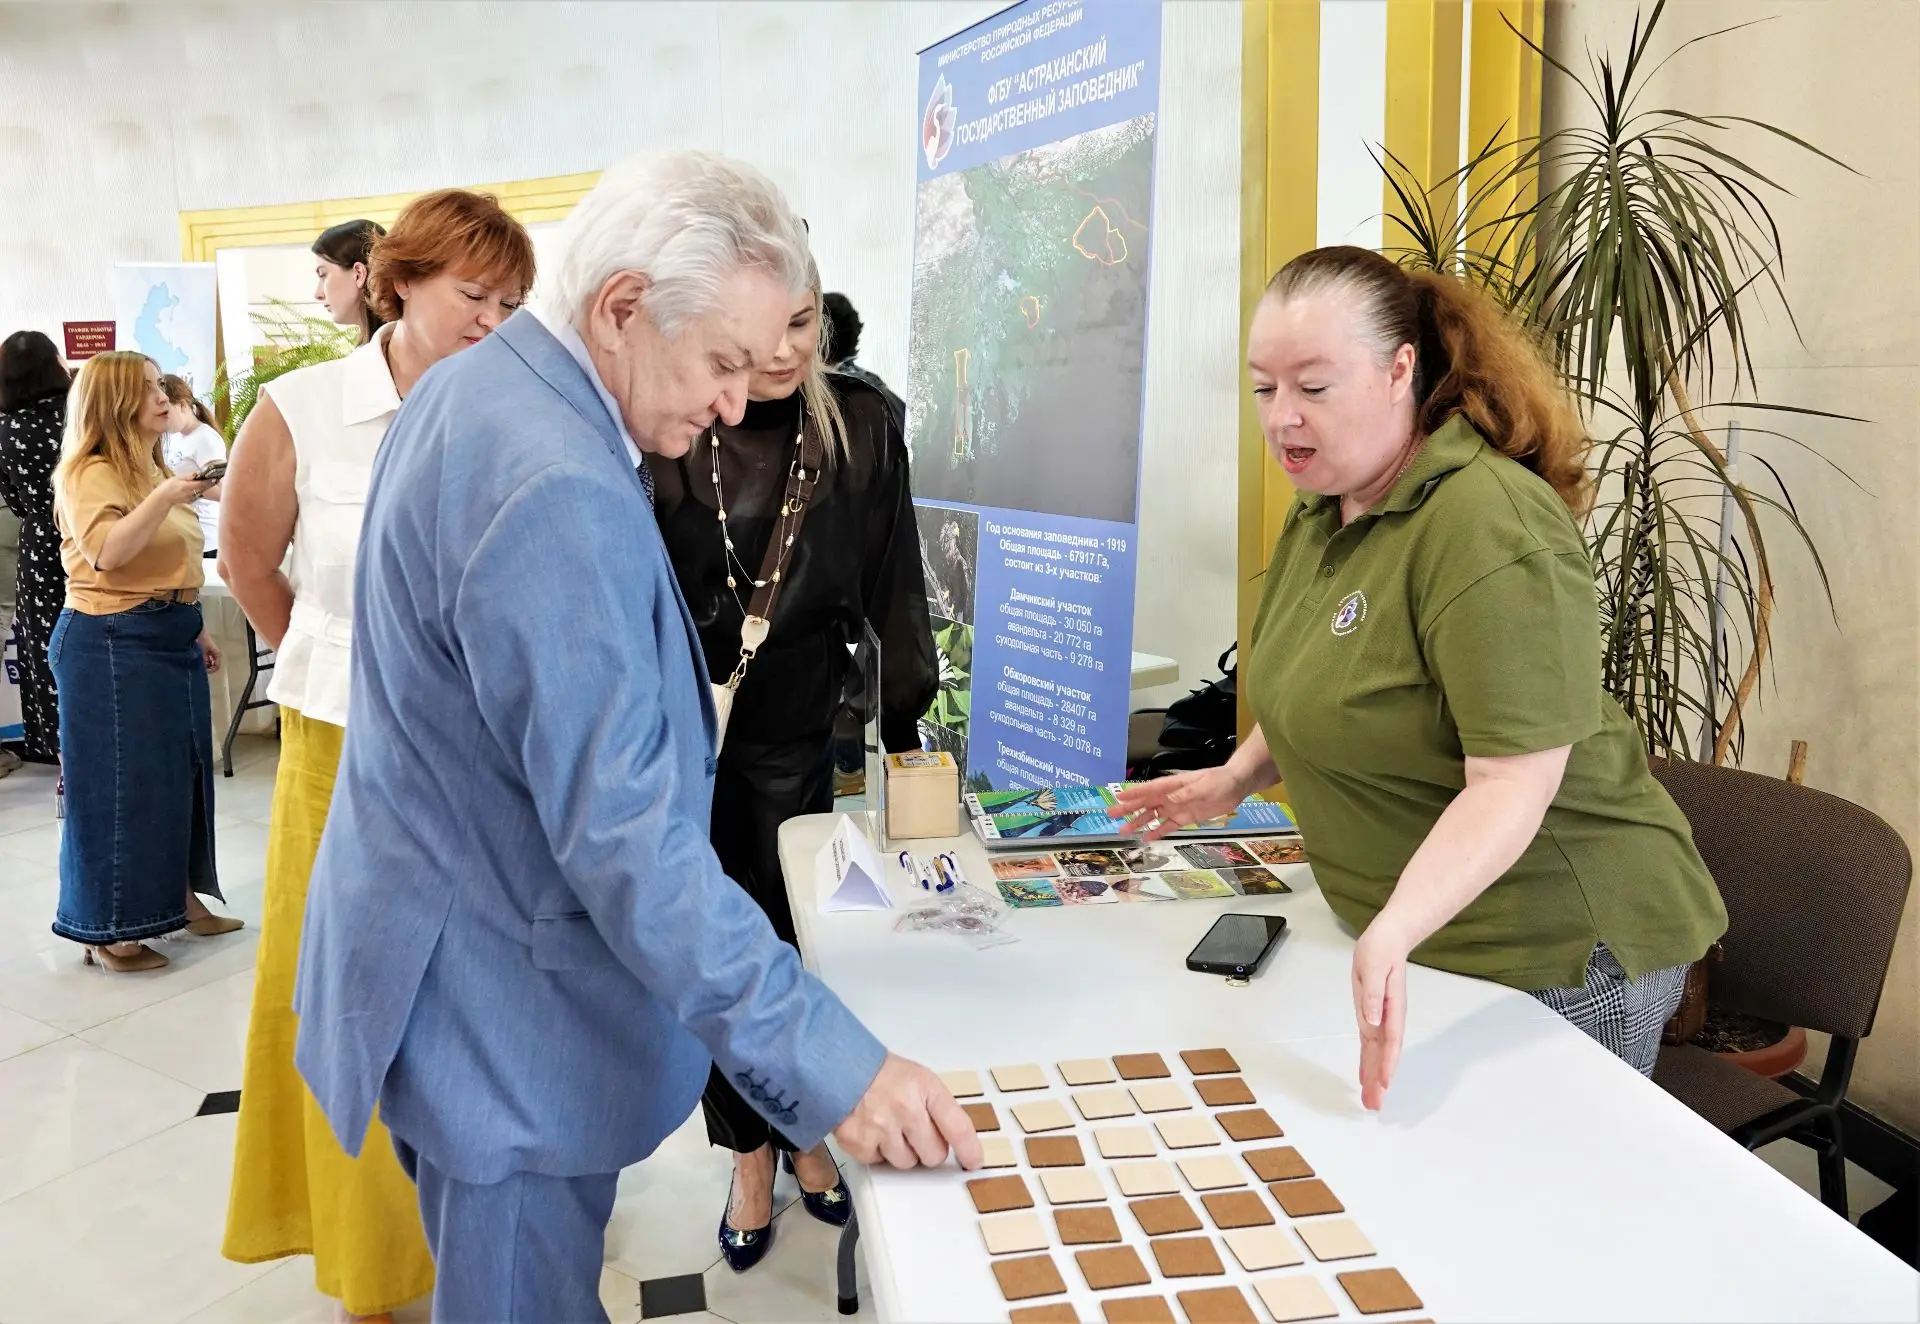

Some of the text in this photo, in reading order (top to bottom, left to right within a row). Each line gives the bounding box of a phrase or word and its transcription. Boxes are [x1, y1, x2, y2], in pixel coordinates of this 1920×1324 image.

[938, 33, 991, 68] МИНИСТЕРСТВО
[992, 9, 1040, 42] ПРИРОДНЫХ
[981, 8, 1082, 63] РОССИЙСКОЙ ФЕДЕРАЦИИ
[988, 76, 1012, 105] ФГБУ
[957, 87, 1056, 146] ГОСУДАРСТВЕННЫЙ
[986, 521, 1001, 536] Год
[1002, 526, 1042, 540] основания
[1043, 531, 1099, 549] заповедника
[1106, 537, 1127, 552] 1919
[1000, 539, 1026, 554] Общая
[1027, 546, 1062, 561] площадь
[1069, 549, 1095, 565] 67917
[1097, 553, 1110, 570] Га,
[1004, 557, 1102, 584] состоит из 3-х участков:
[1000, 602, 1023, 617] общая
[1024, 609, 1057, 627] площадь
[1064, 616, 1075, 630] 30
[1077, 618, 1092, 634] 050
[1093, 625, 1103, 637] га
[1010, 588, 1092, 617] Дамчикский участок
[995, 634, 1040, 655] суходольная
[1041, 646, 1063, 661] часть
[1070, 651, 1076, 664] 9
[1077, 653, 1093, 669] 278
[1095, 660, 1104, 672] га
[1007, 621, 1047, 640] авандельта
[1053, 630, 1064, 644] 20
[1065, 633, 1082, 649] 772
[1083, 640, 1092, 652] га
[997, 680, 1020, 697] общая
[1021, 689, 1054, 709] площадь
[1061, 699, 1087, 718] 28407
[1088, 710, 1097, 722] га
[1003, 665, 1092, 702] Обжоровский участок
[989, 710, 1034, 734] суходольная
[1034, 726, 1057, 742] часть
[1063, 733, 1074, 748] 20
[1075, 738, 1091, 754] 078
[1092, 746, 1102, 758] га
[1004, 700, 1044, 722] авандельта
[1053, 713, 1059, 726] 8
[1060, 716, 1076, 732] 329
[1077, 724, 1086, 735] га
[996, 758, 1019, 776] общая
[1020, 769, 1054, 789] площадь
[997, 740, 1090, 787] Трехизбинский участок
